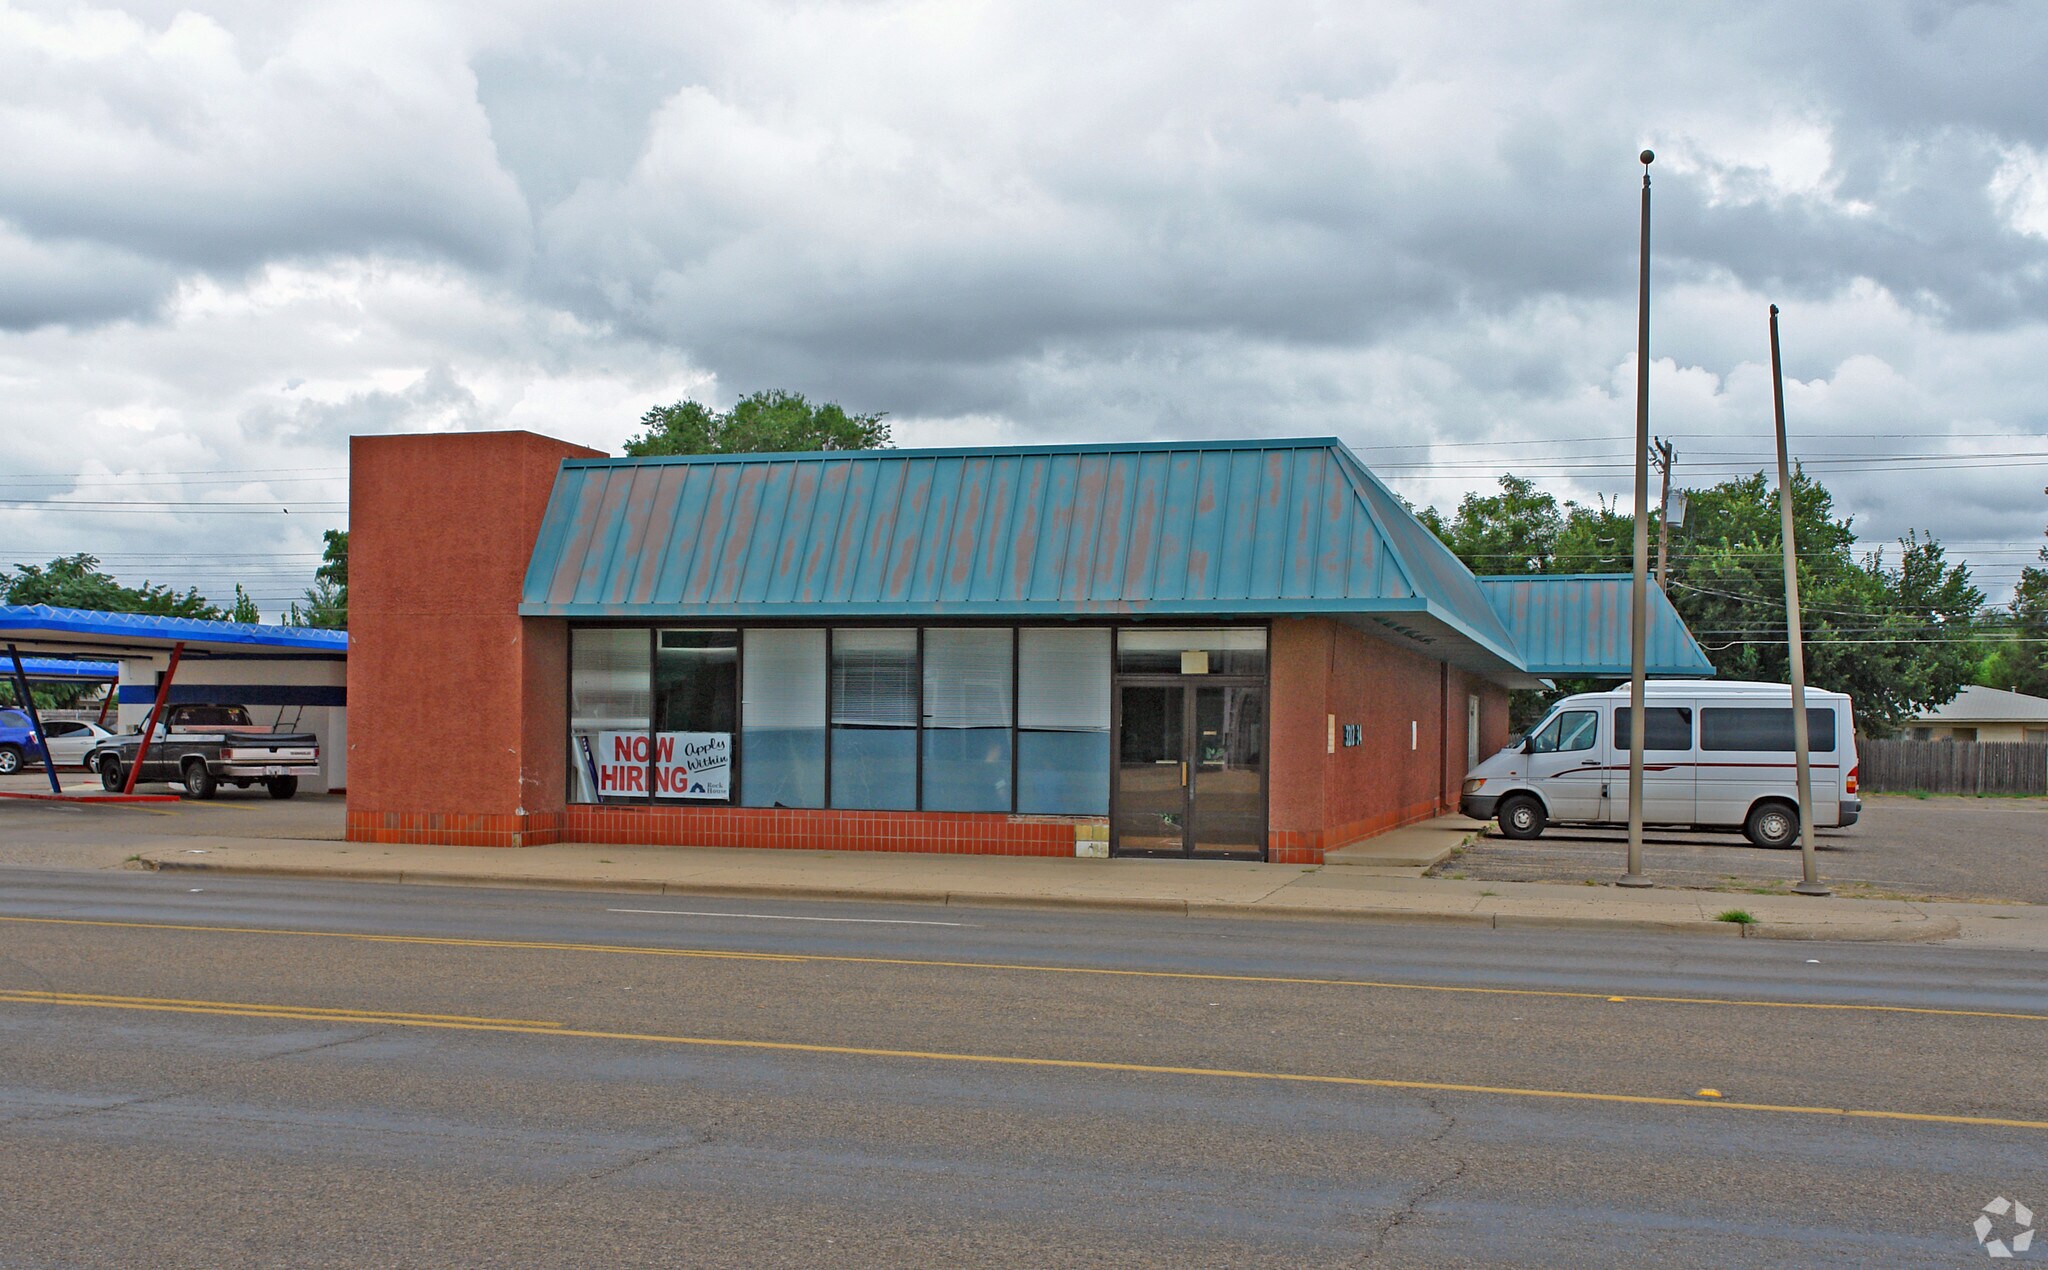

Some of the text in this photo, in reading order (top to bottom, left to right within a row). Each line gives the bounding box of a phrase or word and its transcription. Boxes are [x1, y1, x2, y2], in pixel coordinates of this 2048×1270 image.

[614, 735, 675, 763] NOW
[684, 737, 726, 757] Apply
[686, 755, 728, 771] Within
[601, 764, 688, 793] HIRING
